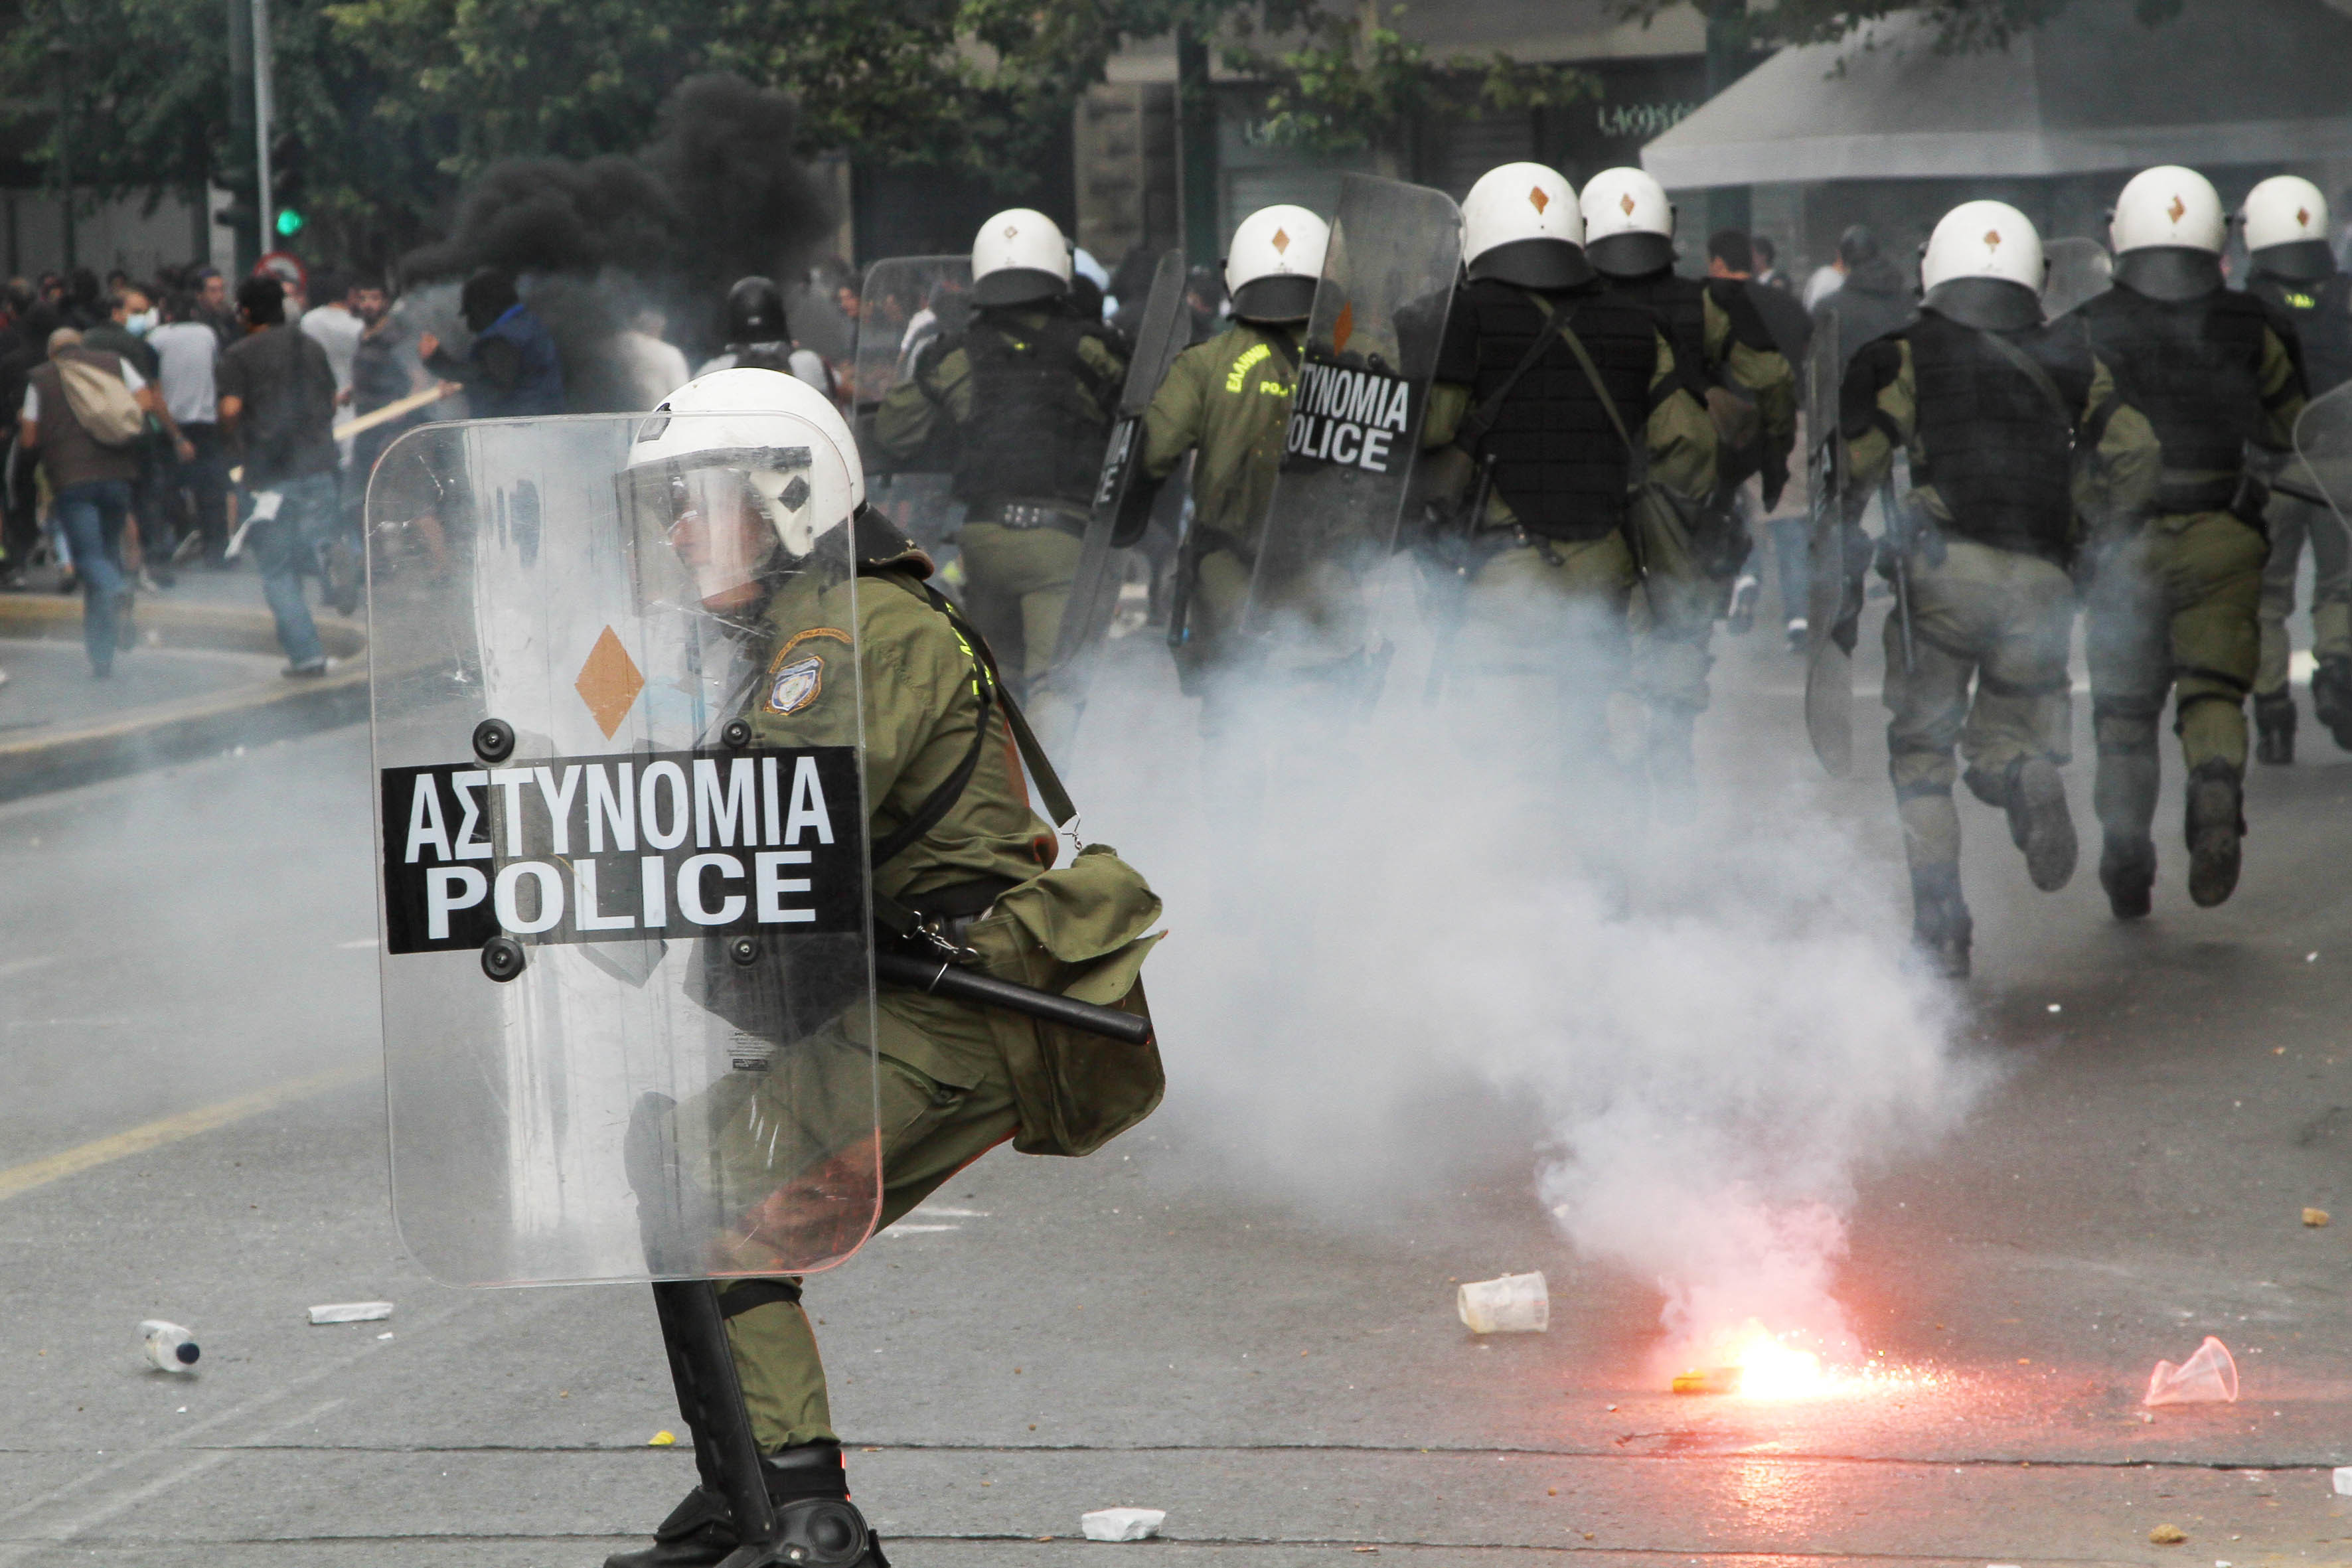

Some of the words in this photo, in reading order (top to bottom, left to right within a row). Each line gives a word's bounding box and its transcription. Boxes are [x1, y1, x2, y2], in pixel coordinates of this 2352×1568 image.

[1298, 362, 1410, 433] ΤΥΝΟΜΙΑ
[1288, 413, 1393, 472] OLICE
[404, 756, 834, 864] ΑΣΤΥΝΟΜΙΑ
[426, 850, 817, 939] POLICE
